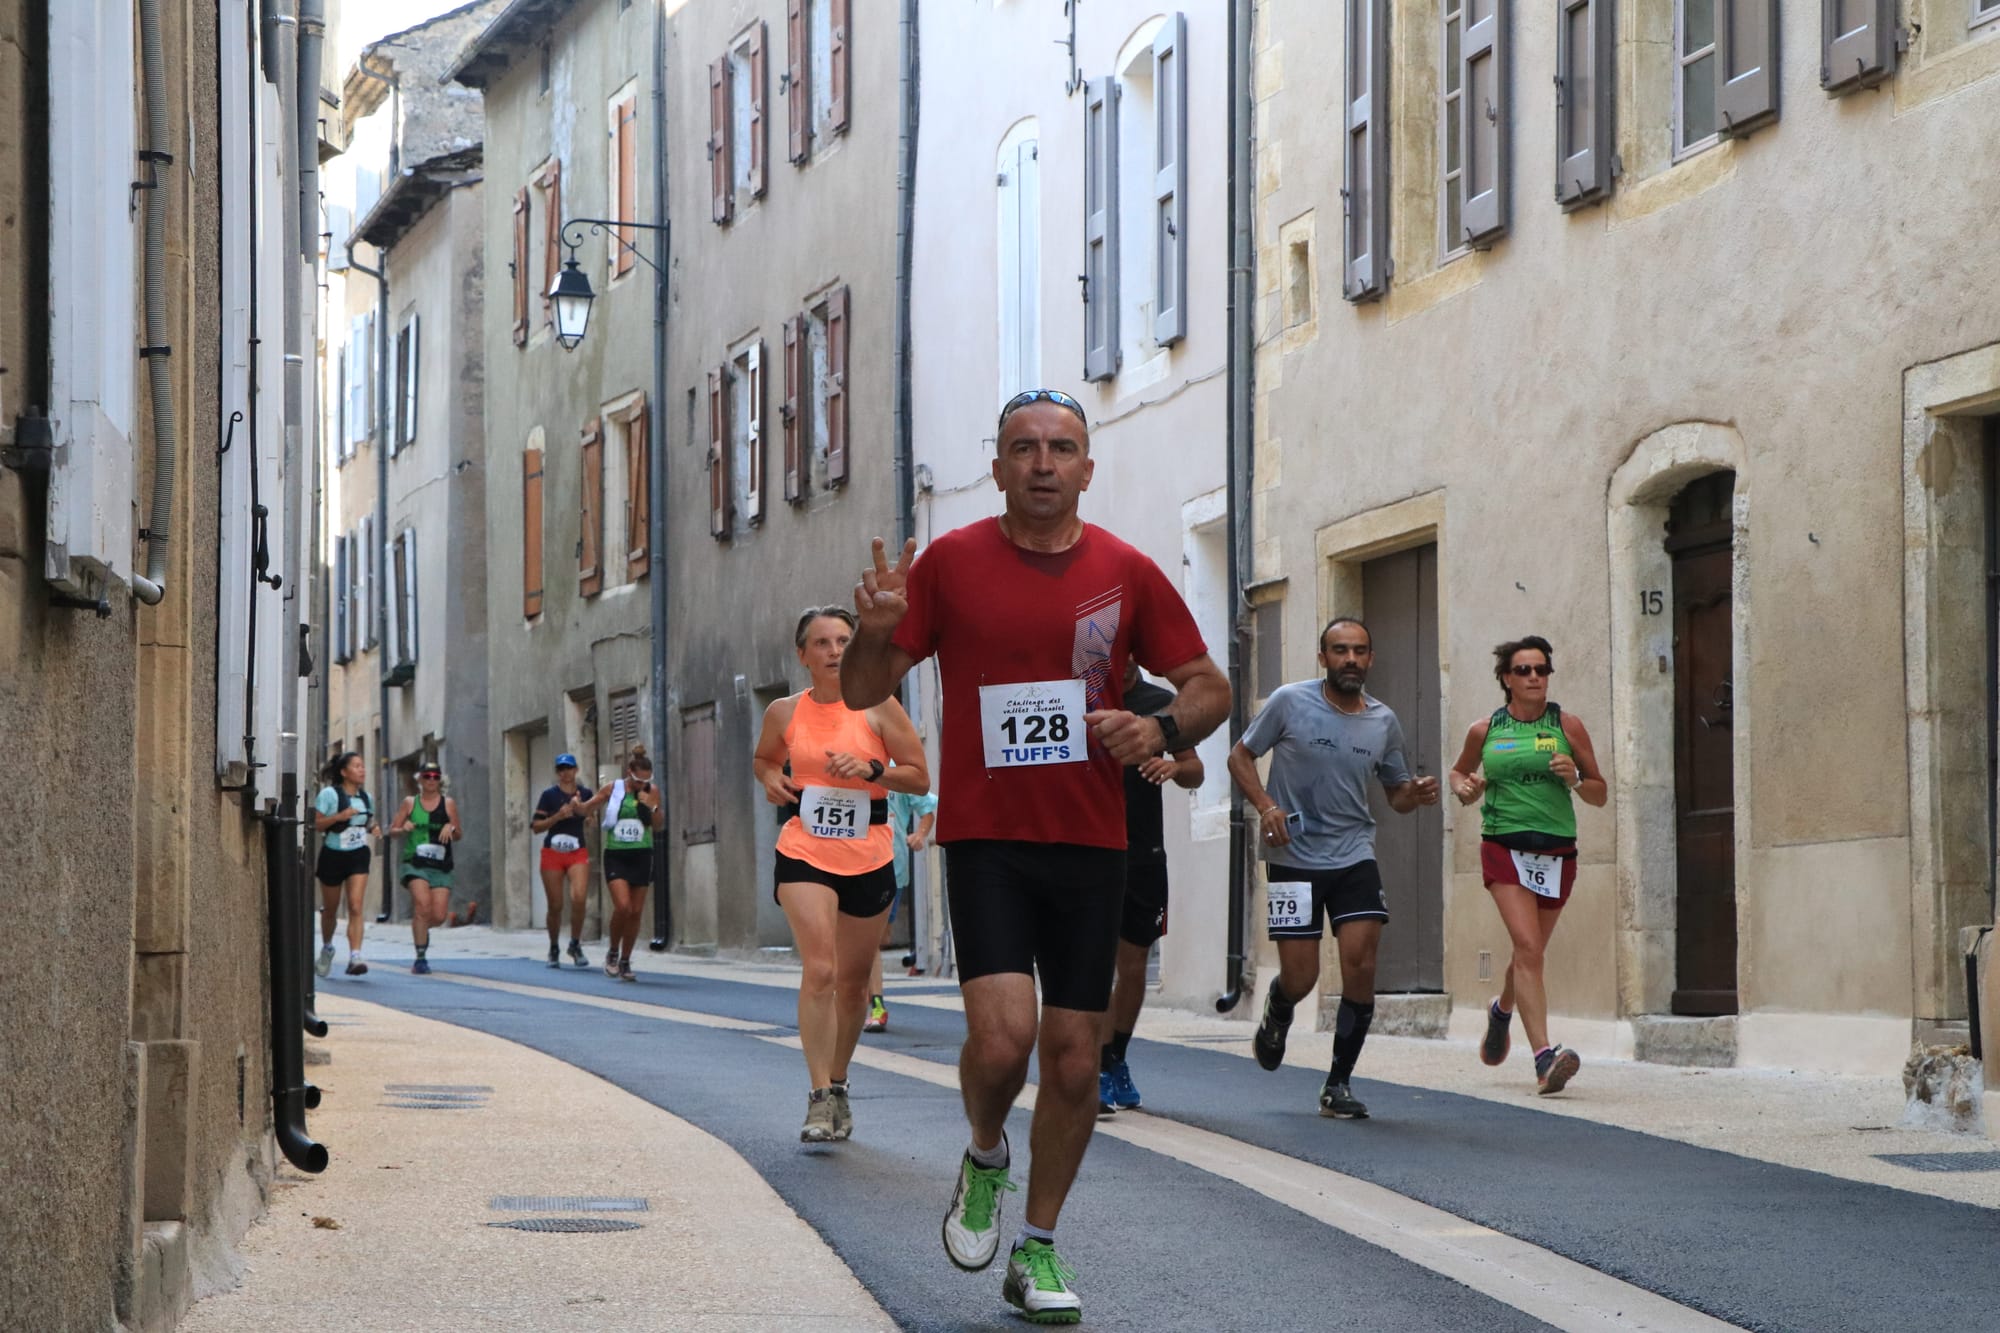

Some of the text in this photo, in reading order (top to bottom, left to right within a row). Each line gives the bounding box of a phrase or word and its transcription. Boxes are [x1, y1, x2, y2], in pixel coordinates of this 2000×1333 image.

[1640, 590, 1664, 615] 15
[1001, 713, 1070, 745] 128
[1001, 745, 1071, 763] TUFF'S
[814, 806, 856, 827] 151
[620, 828, 640, 837] 149
[812, 825, 856, 838] TUFF'S
[1525, 868, 1546, 886] 76
[1268, 899, 1298, 915] 179
